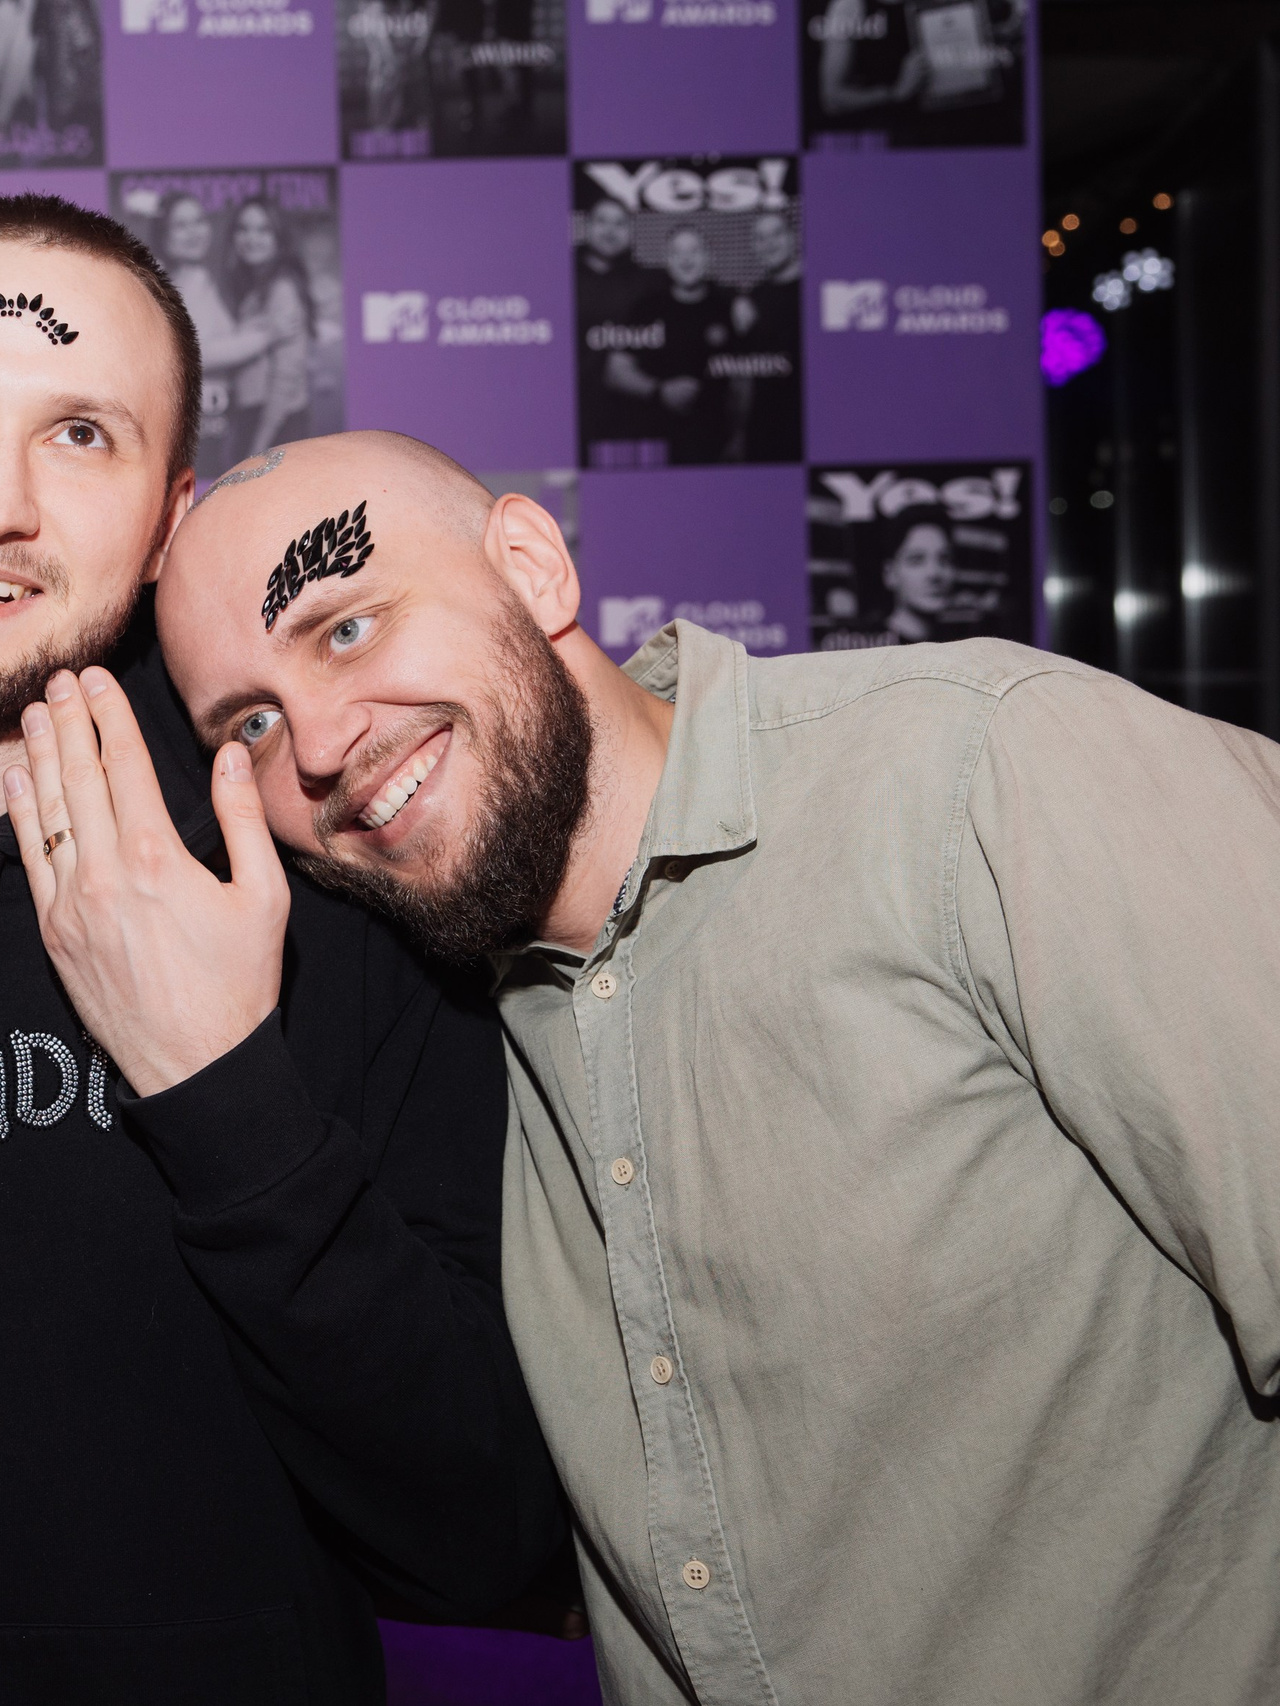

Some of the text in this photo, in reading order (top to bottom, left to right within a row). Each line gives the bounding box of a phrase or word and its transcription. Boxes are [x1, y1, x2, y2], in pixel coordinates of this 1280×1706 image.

[198, 9, 314, 38] AWARDS
[662, 1, 776, 28] AWARDS
[585, 159, 789, 213] Yes!
[437, 297, 529, 323] CLOUD
[894, 285, 987, 313] CLOUD
[438, 319, 553, 345] AWARDS
[585, 319, 666, 350] cloud
[896, 308, 1010, 335] AWARDS
[820, 468, 1021, 522] Yes!
